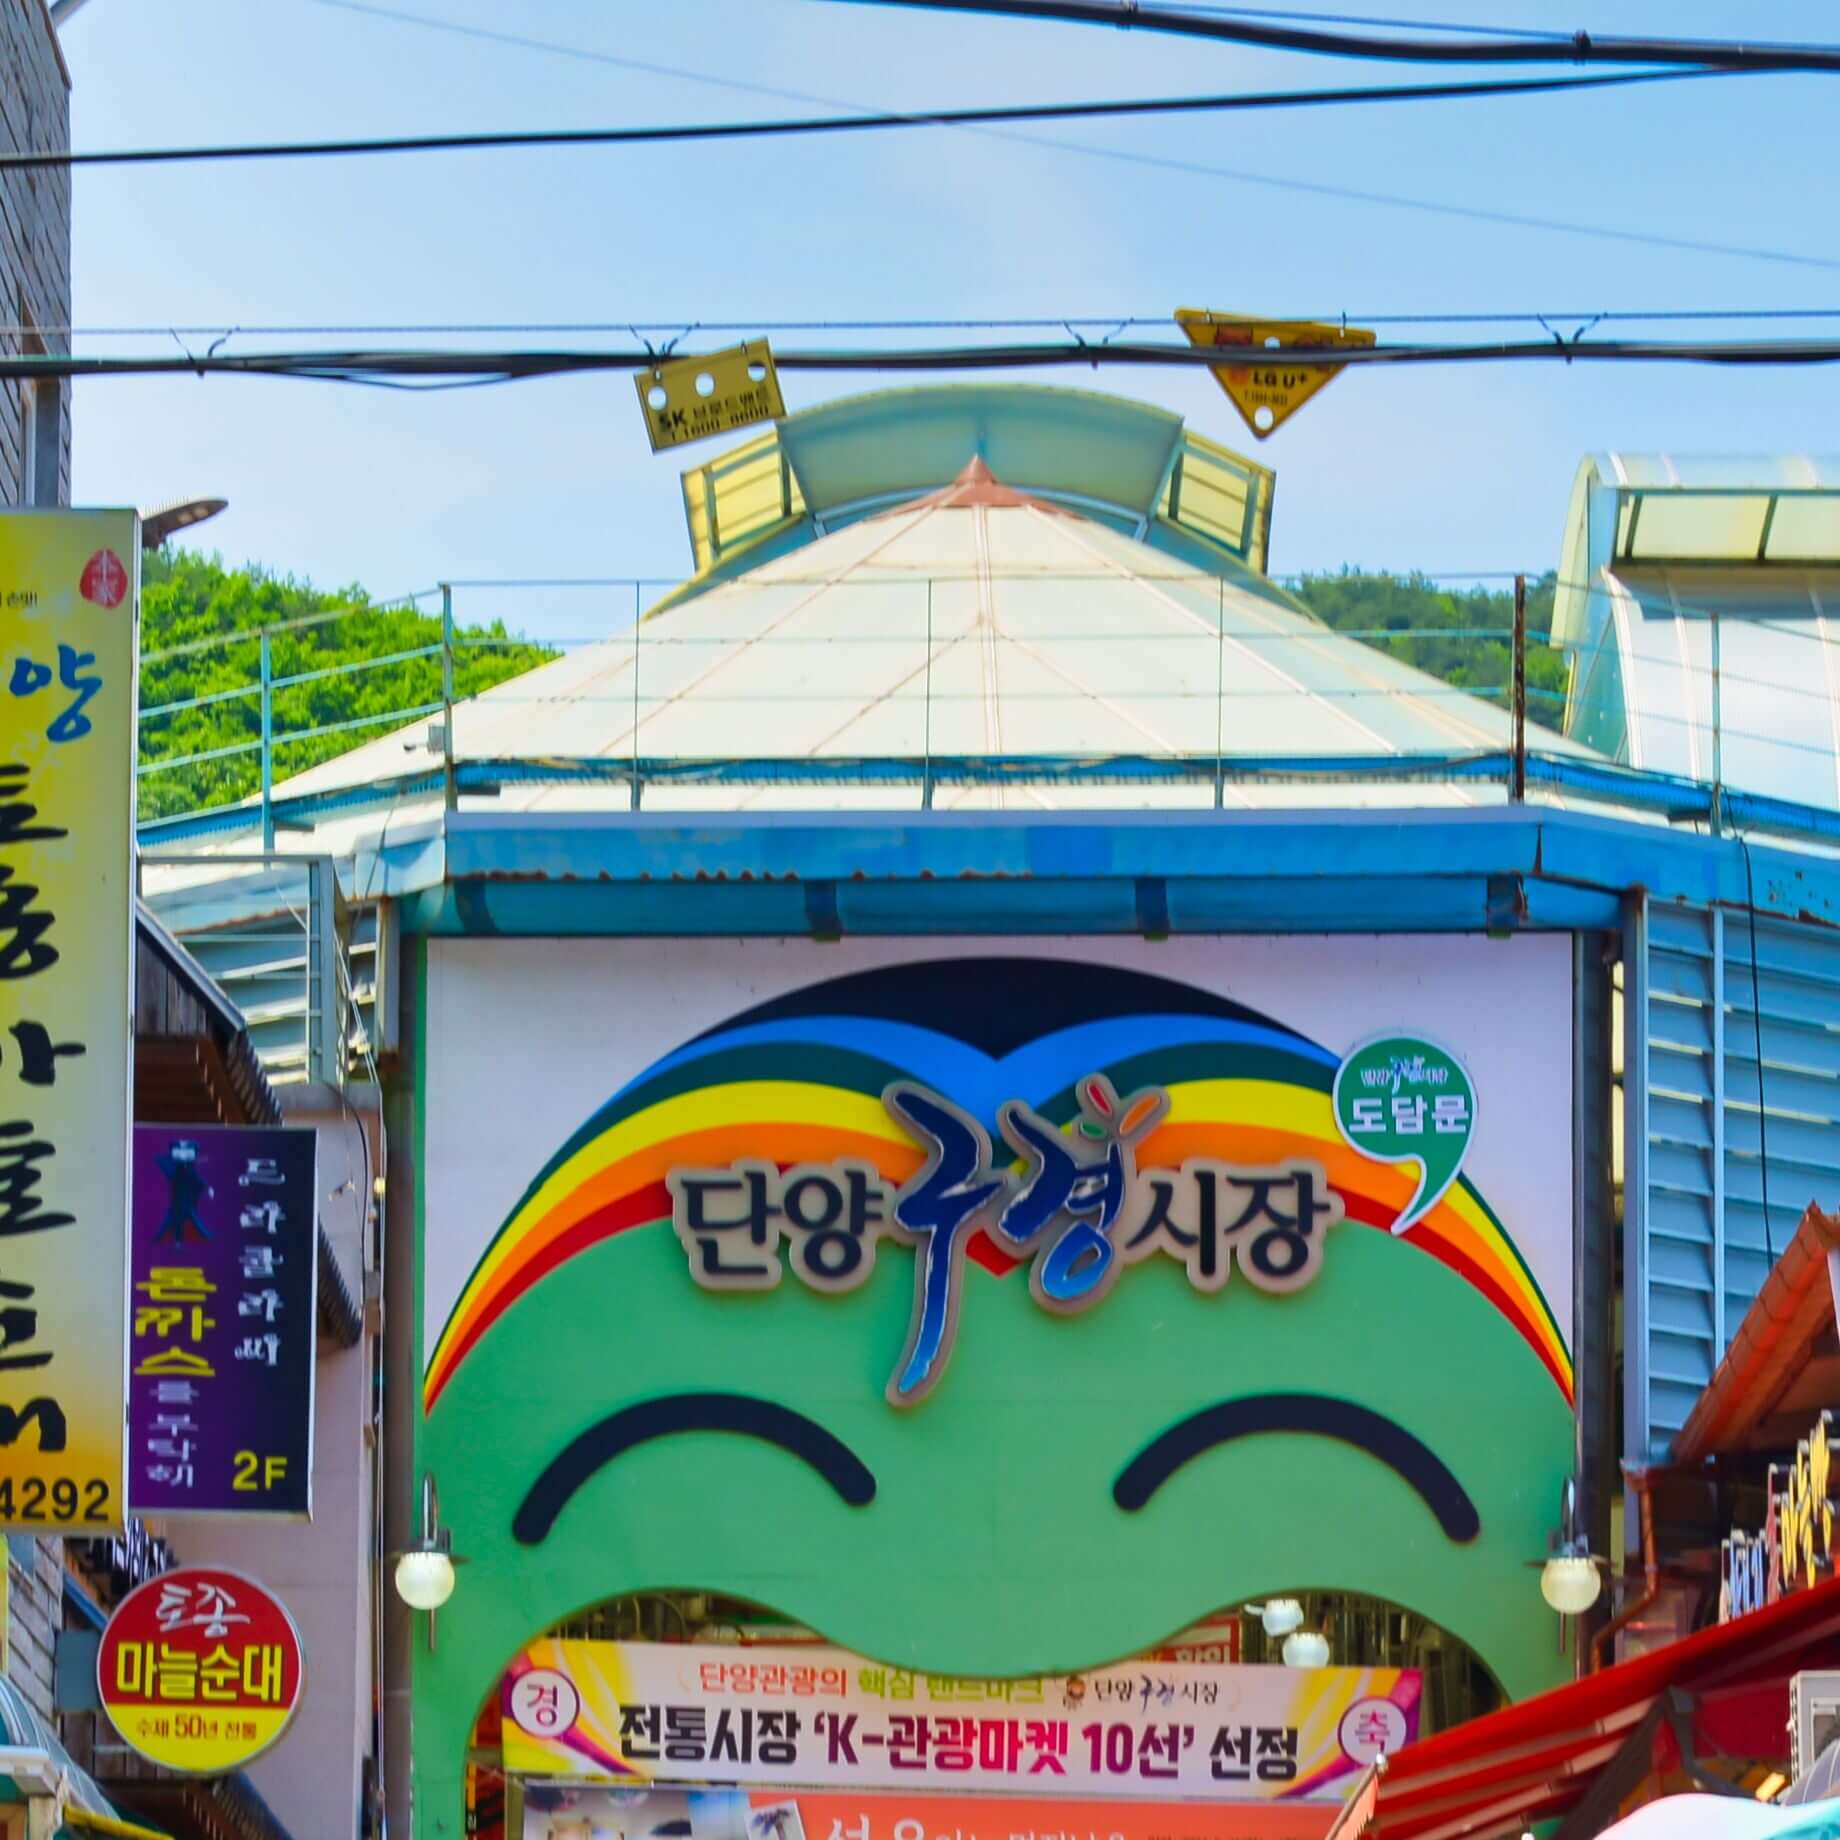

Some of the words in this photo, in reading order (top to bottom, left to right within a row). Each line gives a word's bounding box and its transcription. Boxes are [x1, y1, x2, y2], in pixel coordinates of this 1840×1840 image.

[1348, 1094, 1470, 1135] 도담문
[232, 1449, 288, 1491] 2F
[155, 1581, 252, 1639] 토종
[116, 1641, 284, 1703] 마늘순대
[699, 1662, 847, 1697] 단양관광의
[858, 1666, 917, 1701] 핵심
[174, 1712, 219, 1741] 50년
[526, 1683, 561, 1729] 경
[618, 1703, 802, 1767] 전통시장
[1208, 1726, 1299, 1782] 선정
